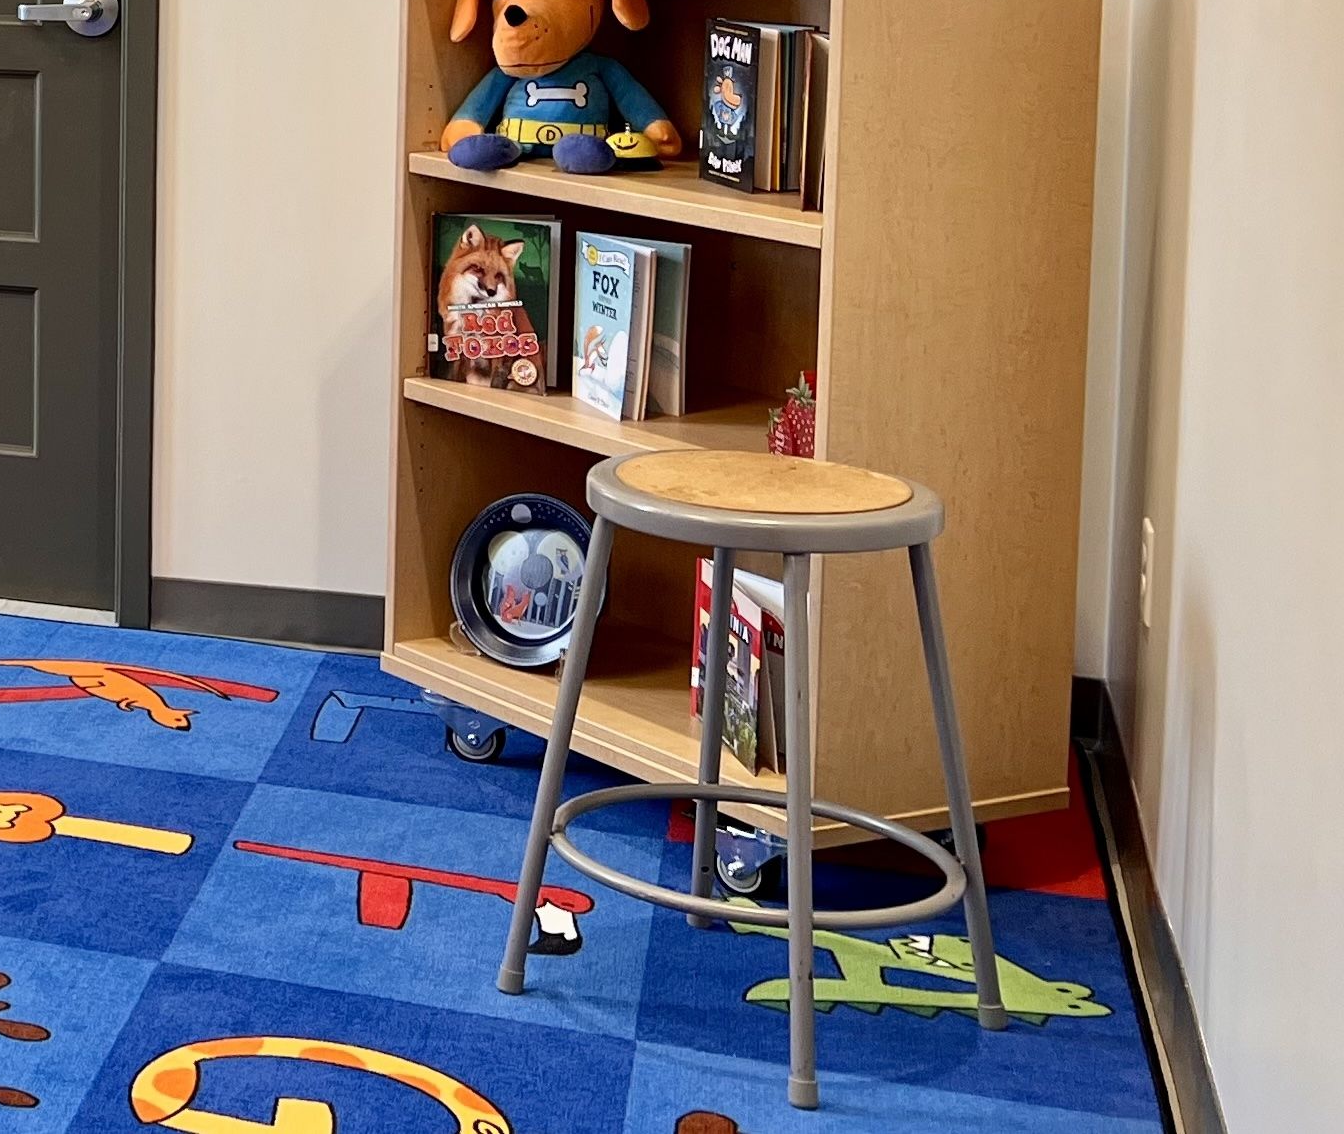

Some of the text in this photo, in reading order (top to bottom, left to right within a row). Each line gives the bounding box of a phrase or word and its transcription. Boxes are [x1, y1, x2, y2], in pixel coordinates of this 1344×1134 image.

[710, 33, 753, 65] DOG MAN
[546, 129, 556, 141] D
[593, 271, 619, 298] FOX
[461, 310, 516, 334] Red
[592, 301, 617, 320] WINTER
